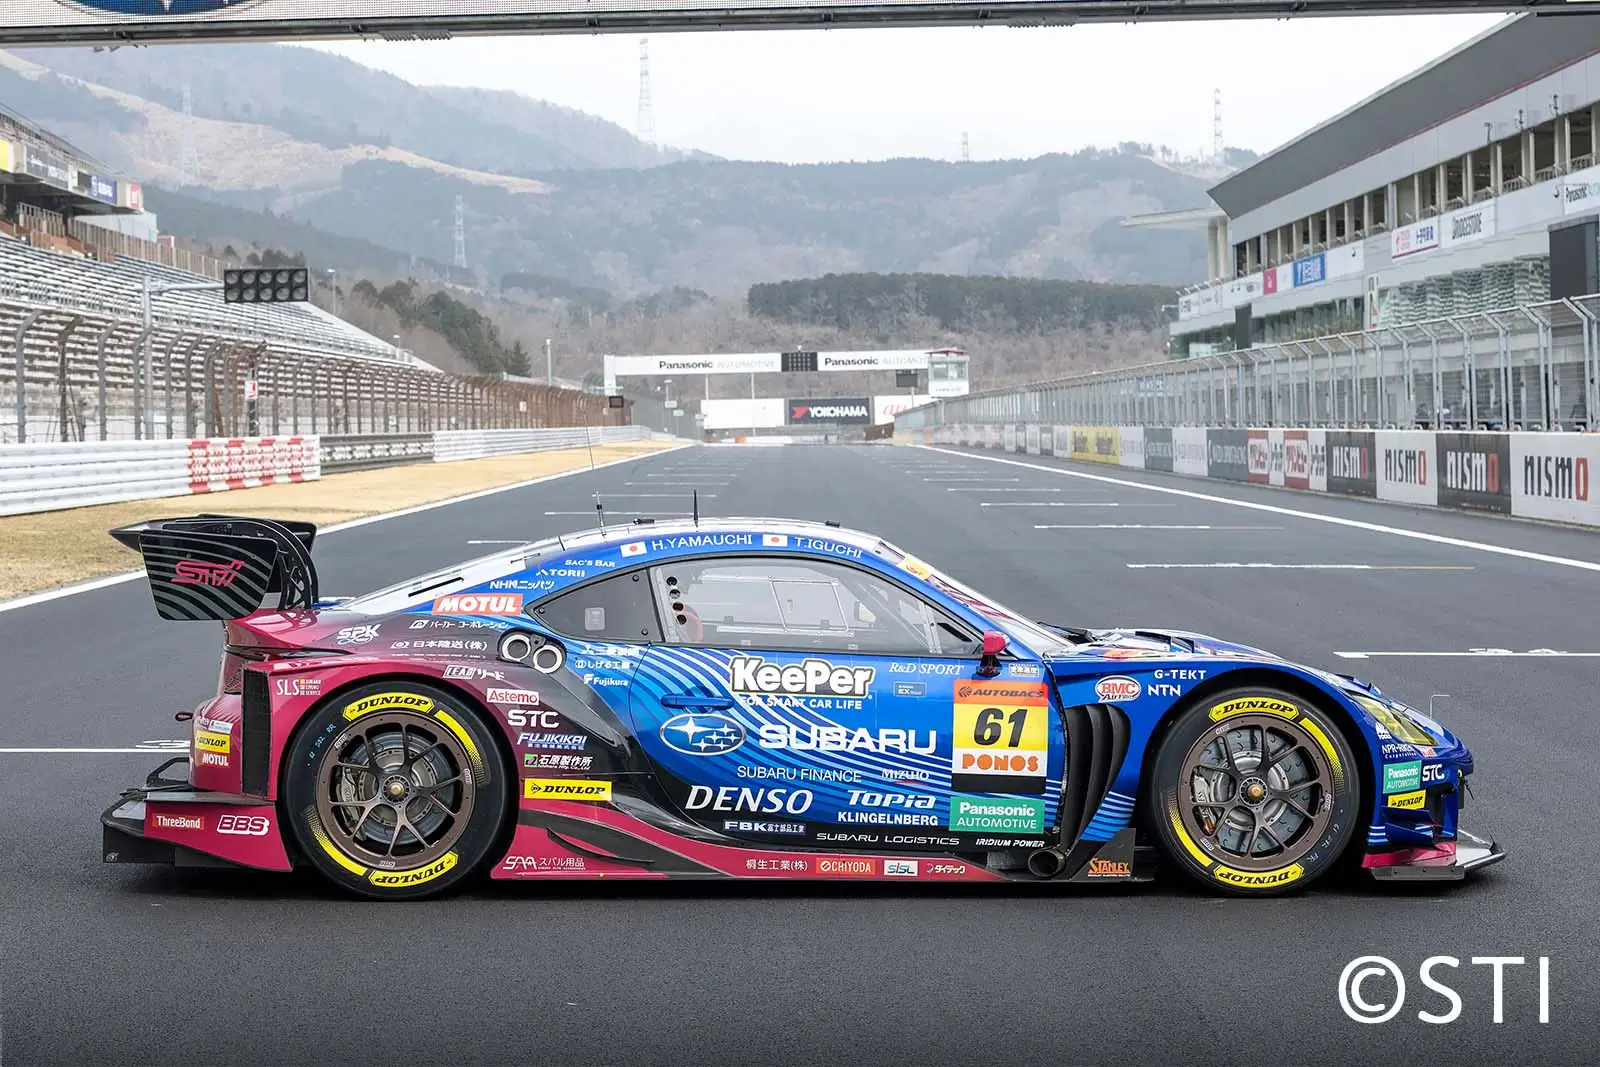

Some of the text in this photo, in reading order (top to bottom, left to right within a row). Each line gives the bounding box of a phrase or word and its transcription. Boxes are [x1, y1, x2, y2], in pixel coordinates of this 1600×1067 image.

[659, 360, 713, 369] Panasonic
[824, 356, 878, 367] Panasonic
[809, 407, 867, 420] YOKOHAMA
[652, 534, 753, 550] H.YAMAUCHI
[794, 538, 863, 559] T.IGUCHI
[437, 597, 516, 613] MOTUL
[336, 624, 382, 641] SPK
[889, 662, 964, 675] R&D SPORT
[1154, 669, 1207, 680] G-TEKT
[594, 677, 629, 687] Fujikura
[730, 656, 875, 698] KeePer
[276, 679, 300, 696] SLS
[973, 688, 1044, 698] AUTOBACS
[1101, 683, 1136, 695] BMC
[1147, 684, 1181, 697] NTN
[357, 696, 429, 712] DUNLOP
[488, 690, 538, 704] Astemo
[766, 697, 807, 708] SMART
[809, 698, 832, 709] CAR
[836, 699, 862, 710] LIFE
[1222, 701, 1294, 714] DUNLOP
[508, 709, 560, 728] STC
[973, 708, 1028, 748] 61
[517, 733, 587, 746] FUJIKIKAI
[759, 724, 937, 755] SUBARU
[202, 753, 229, 766] MOTUL
[962, 753, 1039, 772] PONOS
[737, 766, 862, 783] SUBARU FINANCE
[1388, 767, 1418, 778] Panasonic
[1422, 764, 1445, 781] STC
[542, 785, 606, 794] DUNLOP
[685, 785, 813, 814] DENSO
[959, 802, 1035, 817] Panasonic
[157, 815, 201, 829] ThreeBond
[216, 814, 270, 835] BBS
[838, 812, 938, 826] KLINGELNBERG
[957, 817, 1037, 829] AUTOMOTIVE
[724, 821, 767, 832] FBK
[816, 833, 960, 846] SUBARU LOGISTICS
[976, 838, 1045, 848] IRIDIUM POWER
[540, 857, 585, 867] スバル用品
[831, 860, 872, 873] CHIYODA
[1088, 857, 1131, 873] STANLEY
[375, 863, 446, 884] DUNLOP
[1218, 871, 1292, 885] DUNLOP
